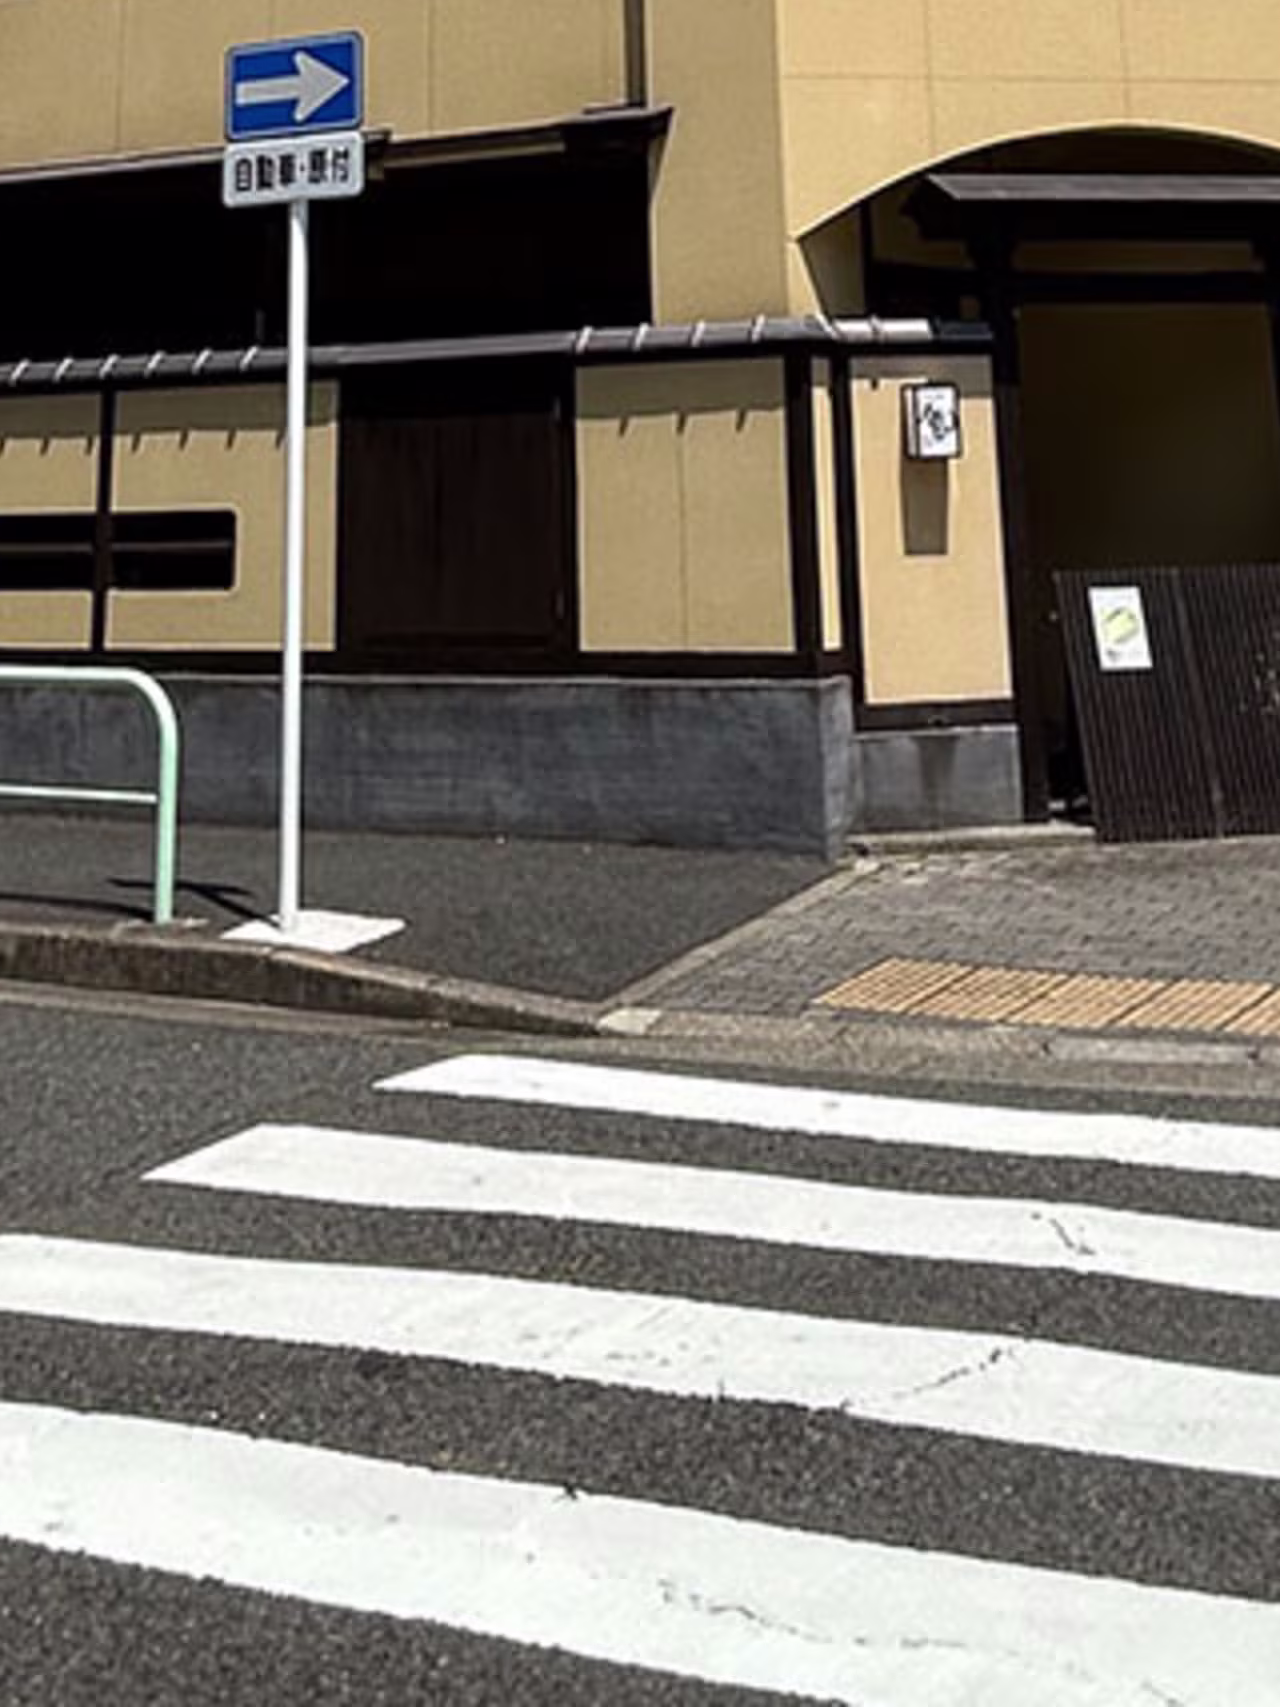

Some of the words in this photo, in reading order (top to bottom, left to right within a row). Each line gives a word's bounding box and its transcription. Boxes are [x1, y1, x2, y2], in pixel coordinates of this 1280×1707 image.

[235, 147, 350, 193] 自動車・原付
